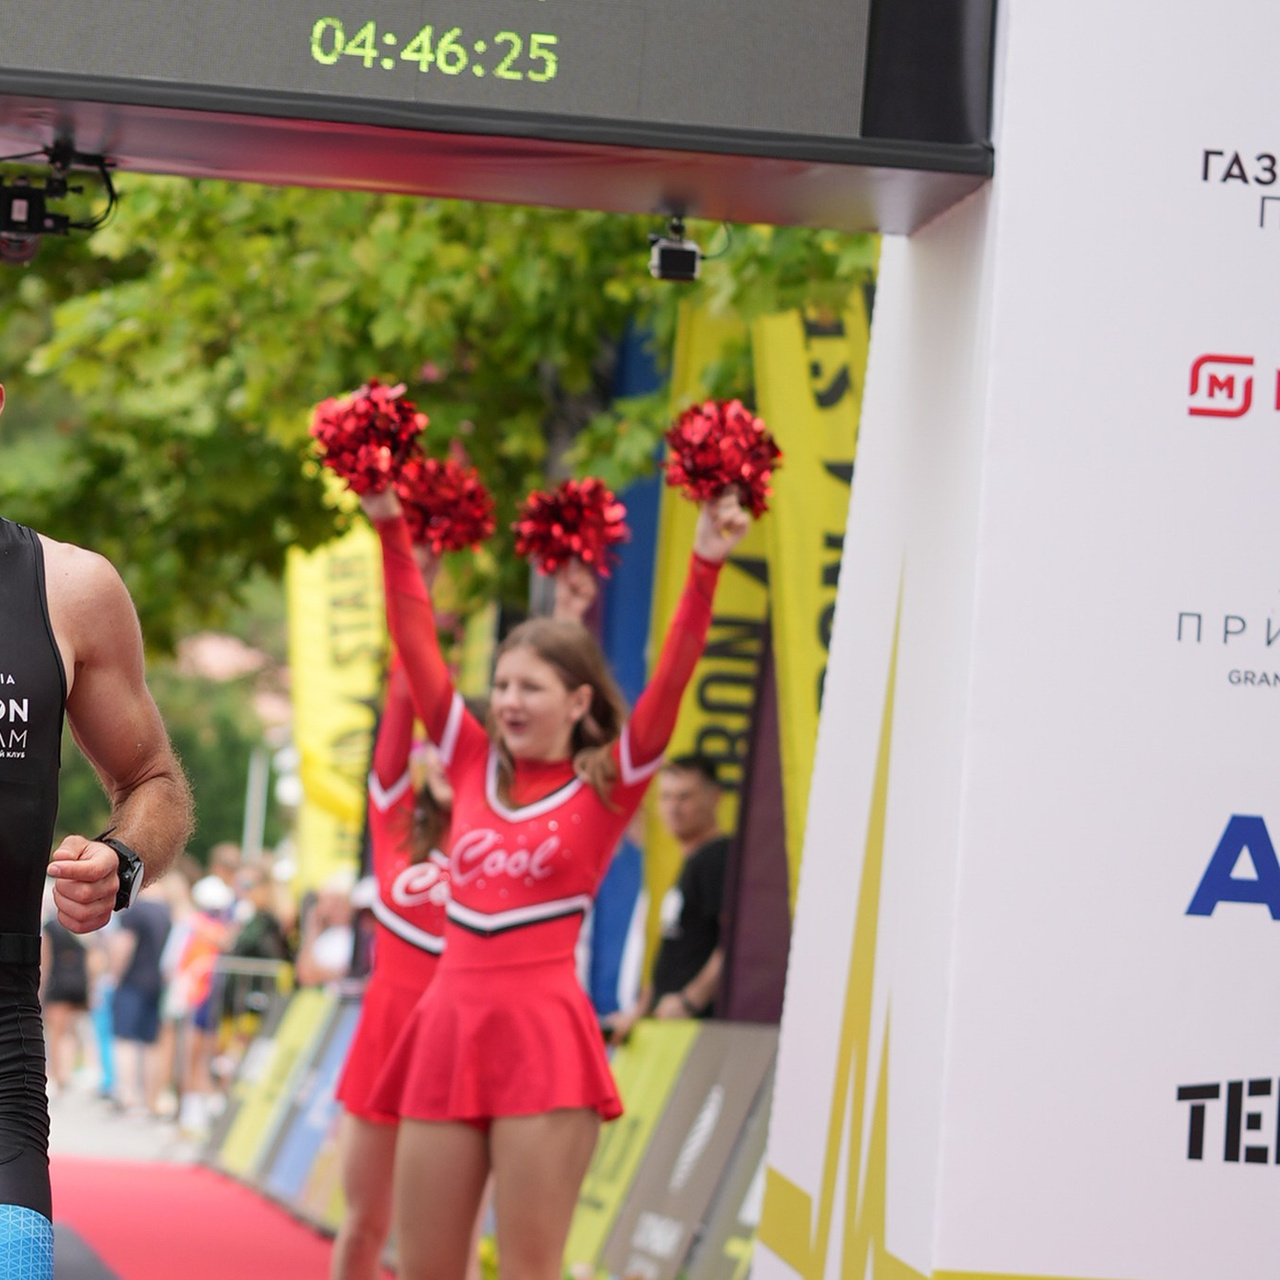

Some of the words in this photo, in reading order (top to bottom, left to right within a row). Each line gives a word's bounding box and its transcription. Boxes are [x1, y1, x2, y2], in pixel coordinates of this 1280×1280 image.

[310, 16, 558, 83] 04:46:25
[6, 750, 26, 758] КЛУБ
[450, 828, 561, 886] Cool
